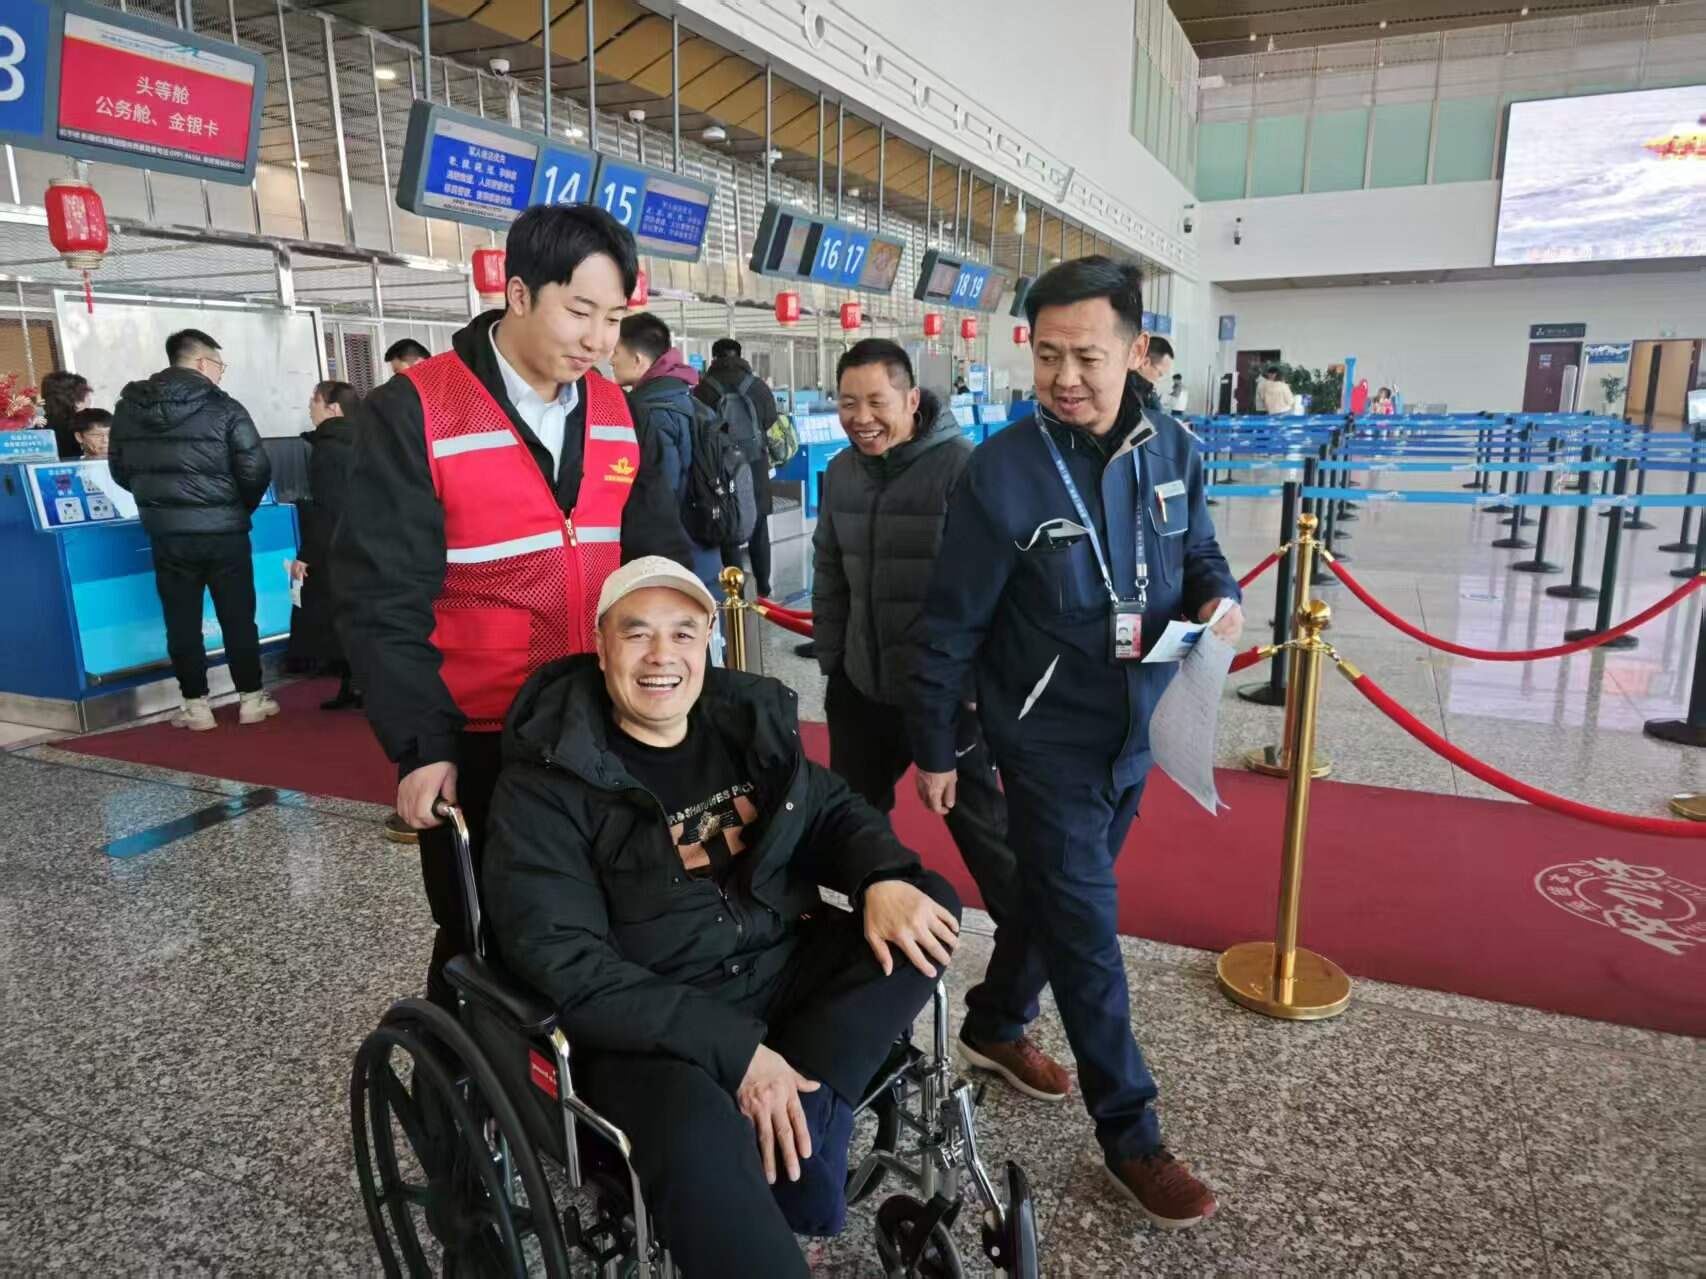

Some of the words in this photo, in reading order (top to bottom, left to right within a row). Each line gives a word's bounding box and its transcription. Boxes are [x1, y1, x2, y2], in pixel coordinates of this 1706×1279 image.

[136, 76, 191, 106] 头等舱
[96, 95, 220, 137] 公务舱、金银卡
[544, 164, 581, 208] 14
[604, 181, 637, 226] 15
[820, 237, 843, 270] 16
[844, 243, 865, 275] 17
[955, 272, 970, 297] 18
[969, 275, 984, 299] 19
